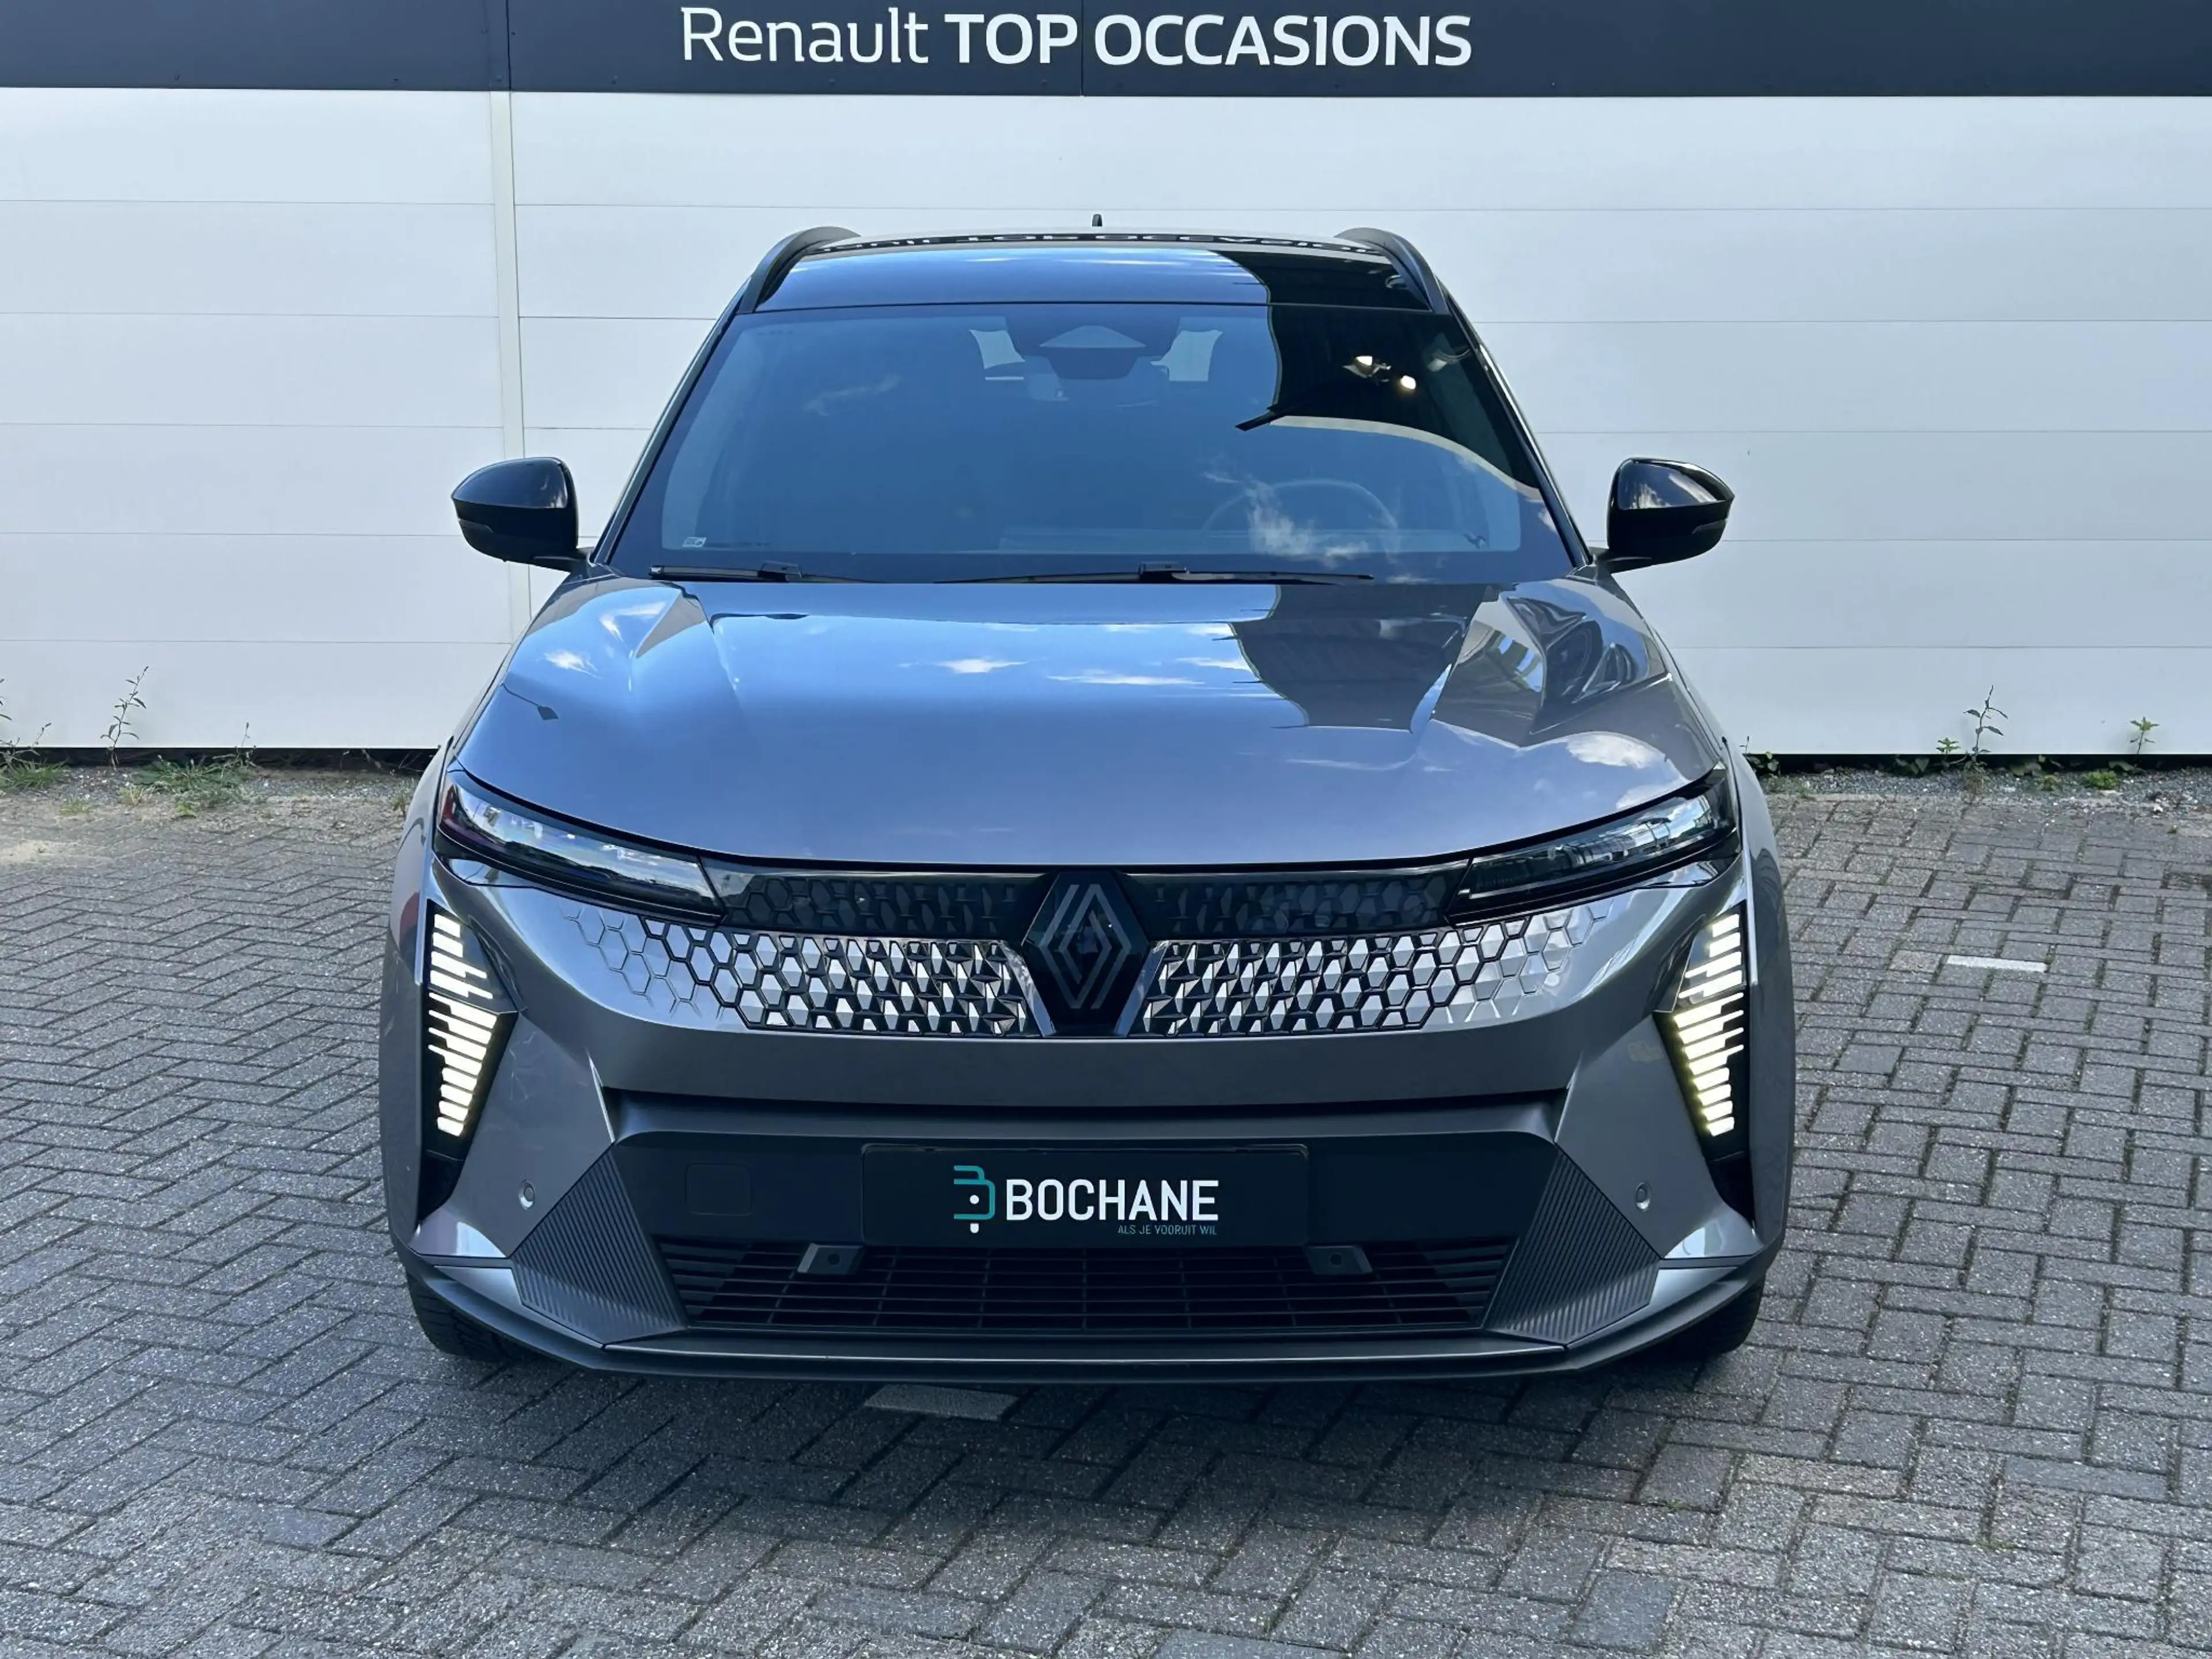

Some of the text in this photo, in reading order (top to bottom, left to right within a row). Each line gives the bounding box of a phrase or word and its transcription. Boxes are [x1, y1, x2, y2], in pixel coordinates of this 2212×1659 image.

[680, 6, 1472, 66] Renault TOP OCCASIONS
[1006, 1179, 1219, 1221] BOCHANE
[1118, 1224, 1217, 1235] ALS JE VOORUIT WIL
